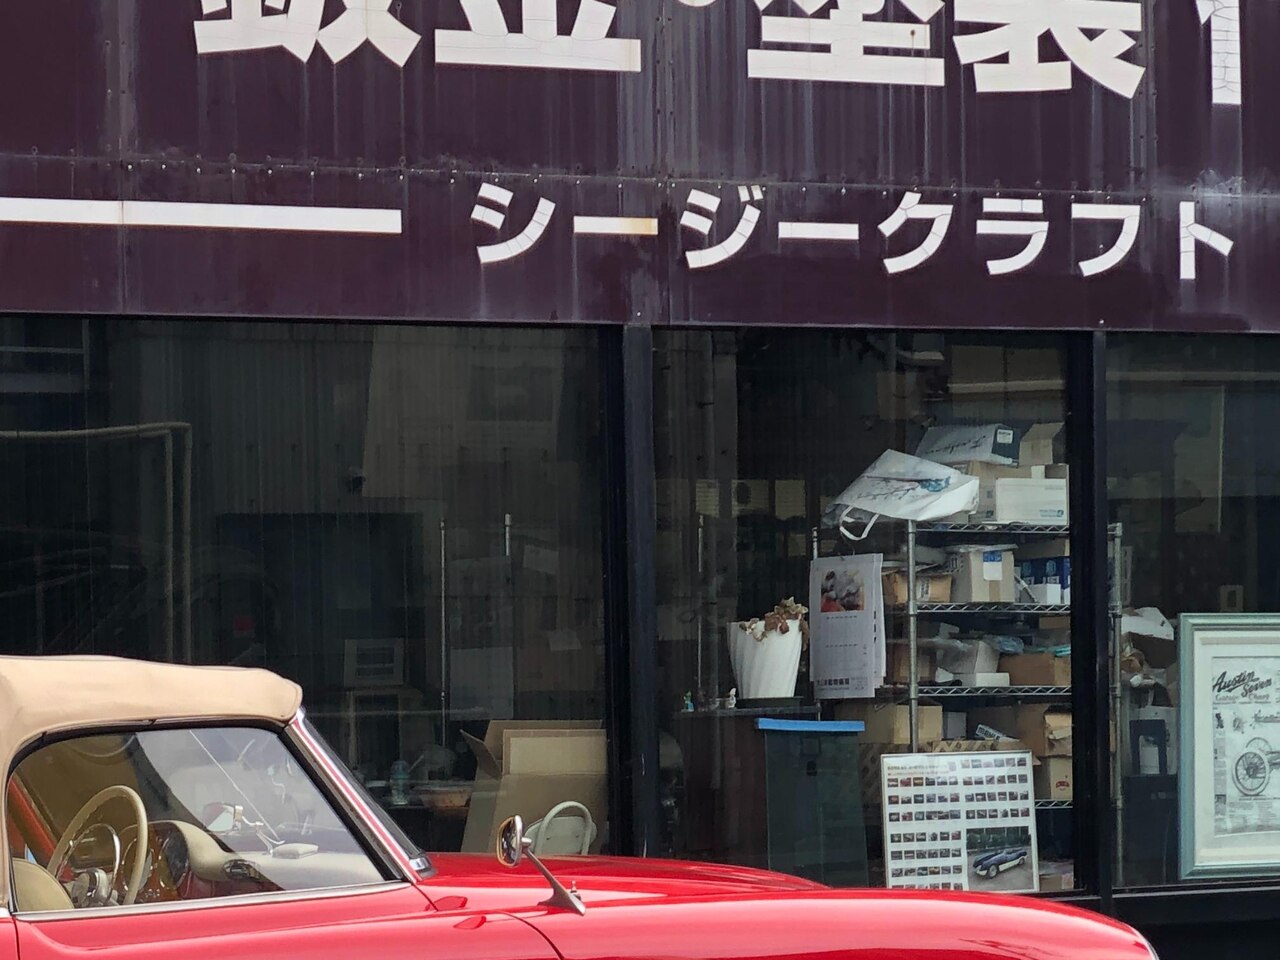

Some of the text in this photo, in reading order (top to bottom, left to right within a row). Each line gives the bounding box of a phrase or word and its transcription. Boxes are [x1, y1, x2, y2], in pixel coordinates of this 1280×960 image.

[471, 183, 1234, 280] シージークラフト
[1212, 670, 1260, 693] Austin
